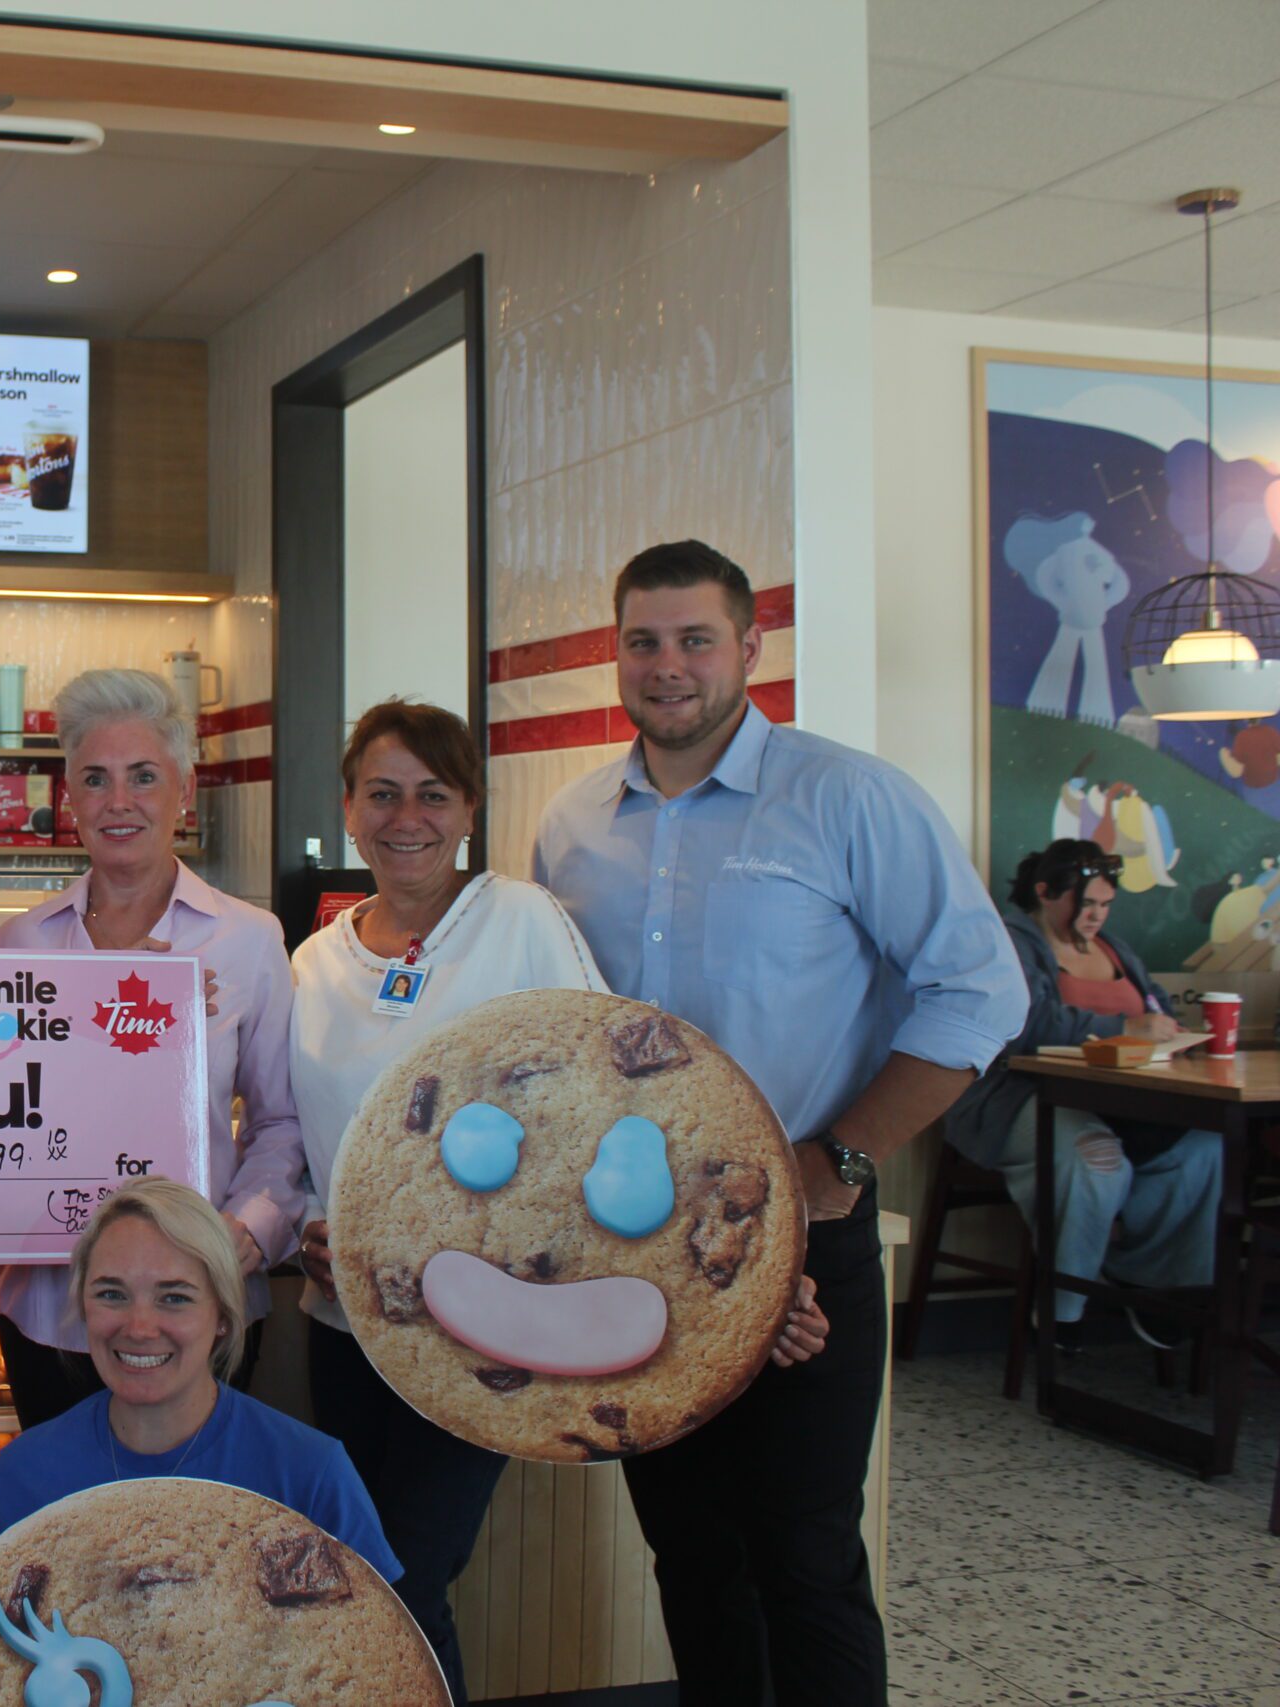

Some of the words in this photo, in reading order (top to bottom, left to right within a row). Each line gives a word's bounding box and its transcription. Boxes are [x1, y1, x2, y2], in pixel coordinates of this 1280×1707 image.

[722, 855, 745, 870] Tim
[745, 857, 794, 875] Hortons
[102, 1001, 168, 1036] Tims
[115, 1152, 154, 1177] for
[64, 1205, 90, 1218] The
